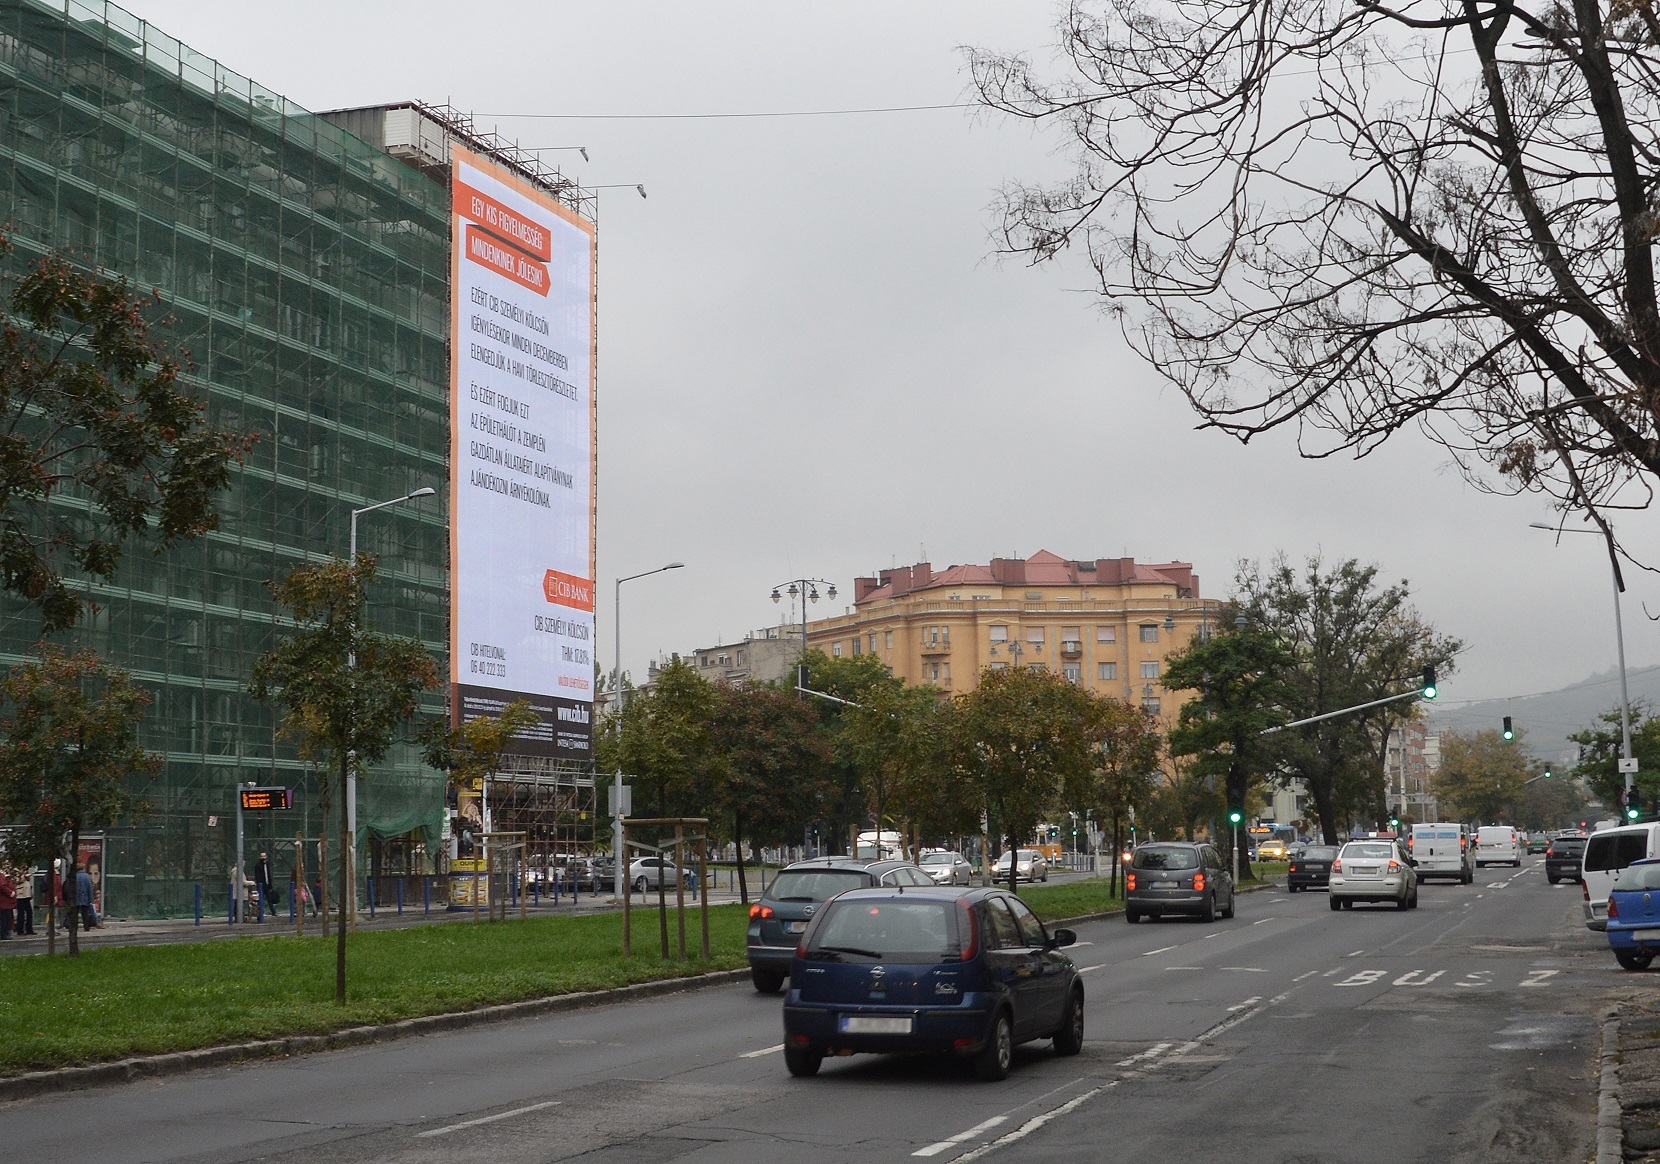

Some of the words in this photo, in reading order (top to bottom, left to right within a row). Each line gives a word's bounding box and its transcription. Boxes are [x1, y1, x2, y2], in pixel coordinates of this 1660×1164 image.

[471, 196, 485, 218] EGY
[486, 202, 497, 226] KIS
[498, 210, 543, 250] FIGYELMESSÉG
[471, 235, 515, 274] MINDENKINEK
[516, 258, 543, 287] JÓLESIK!
[471, 286, 488, 308] EZÉRT
[489, 294, 499, 313] CIB
[500, 299, 524, 325] SZEMÉLYI
[525, 310, 549, 336] KÖLCSÖN
[471, 314, 510, 346] IGÉNYLÉSEKOR
[511, 333, 532, 355] MINDEN
[533, 342, 569, 371] DECEMBERBEN
[471, 343, 505, 371] ELENGEDJÜK
[506, 358, 511, 373] A
[512, 361, 525, 381] HAVI
[471, 380, 478, 400] ÉS
[480, 386, 496, 407] EZÉRT
[497, 393, 519, 416] FOGJUK
[520, 402, 530, 420] EZT
[470, 412, 478, 429] AZ
[480, 412, 516, 442] ÉPÜLETHÁLÓT
[517, 429, 522, 445] A
[523, 431, 546, 453] ZEMPLÉN
[470, 441, 503, 466] GAZDÁTLAN
[470, 468, 508, 496] AJÁNDÉKOZNI
[558, 581, 570, 598] CIB
[571, 584, 589, 602] BANK
[534, 615, 544, 631] CIB
[544, 616, 567, 636] SZEMÉLYI
[567, 620, 589, 640] KÖLCSÖN
[471, 643, 479, 656] CIB
[471, 660, 478, 673] 06
[479, 662, 485, 674] 40
[486, 662, 496, 676] 222
[497, 664, 506, 678] 333
